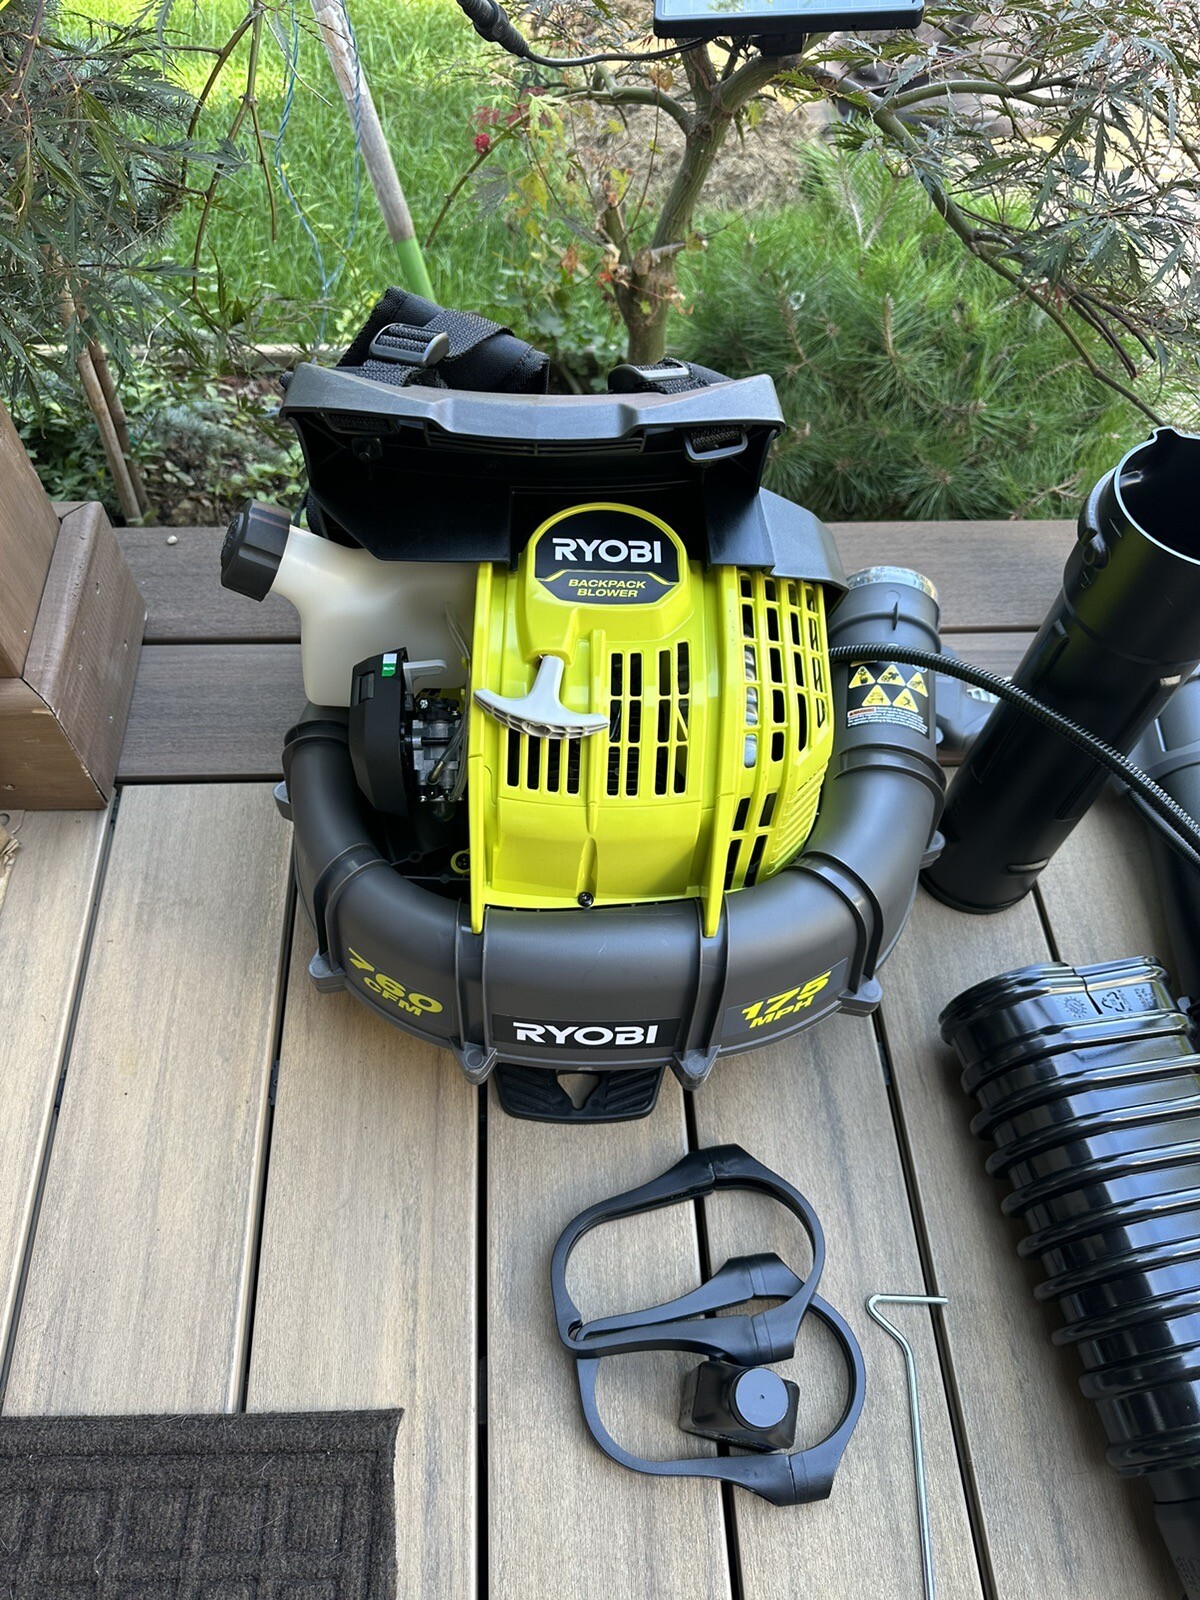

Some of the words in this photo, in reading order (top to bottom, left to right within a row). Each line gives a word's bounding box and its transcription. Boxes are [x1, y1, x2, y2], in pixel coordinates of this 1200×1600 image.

[552, 537, 662, 564] RYOBI
[568, 578, 647, 589] BACKPACK
[576, 588, 639, 598] BLOWER
[348, 946, 443, 1013] 760
[741, 970, 832, 1020] 175
[363, 976, 423, 1016] CFM
[749, 994, 815, 1029] MPH
[513, 1021, 659, 1046] RYOBI
